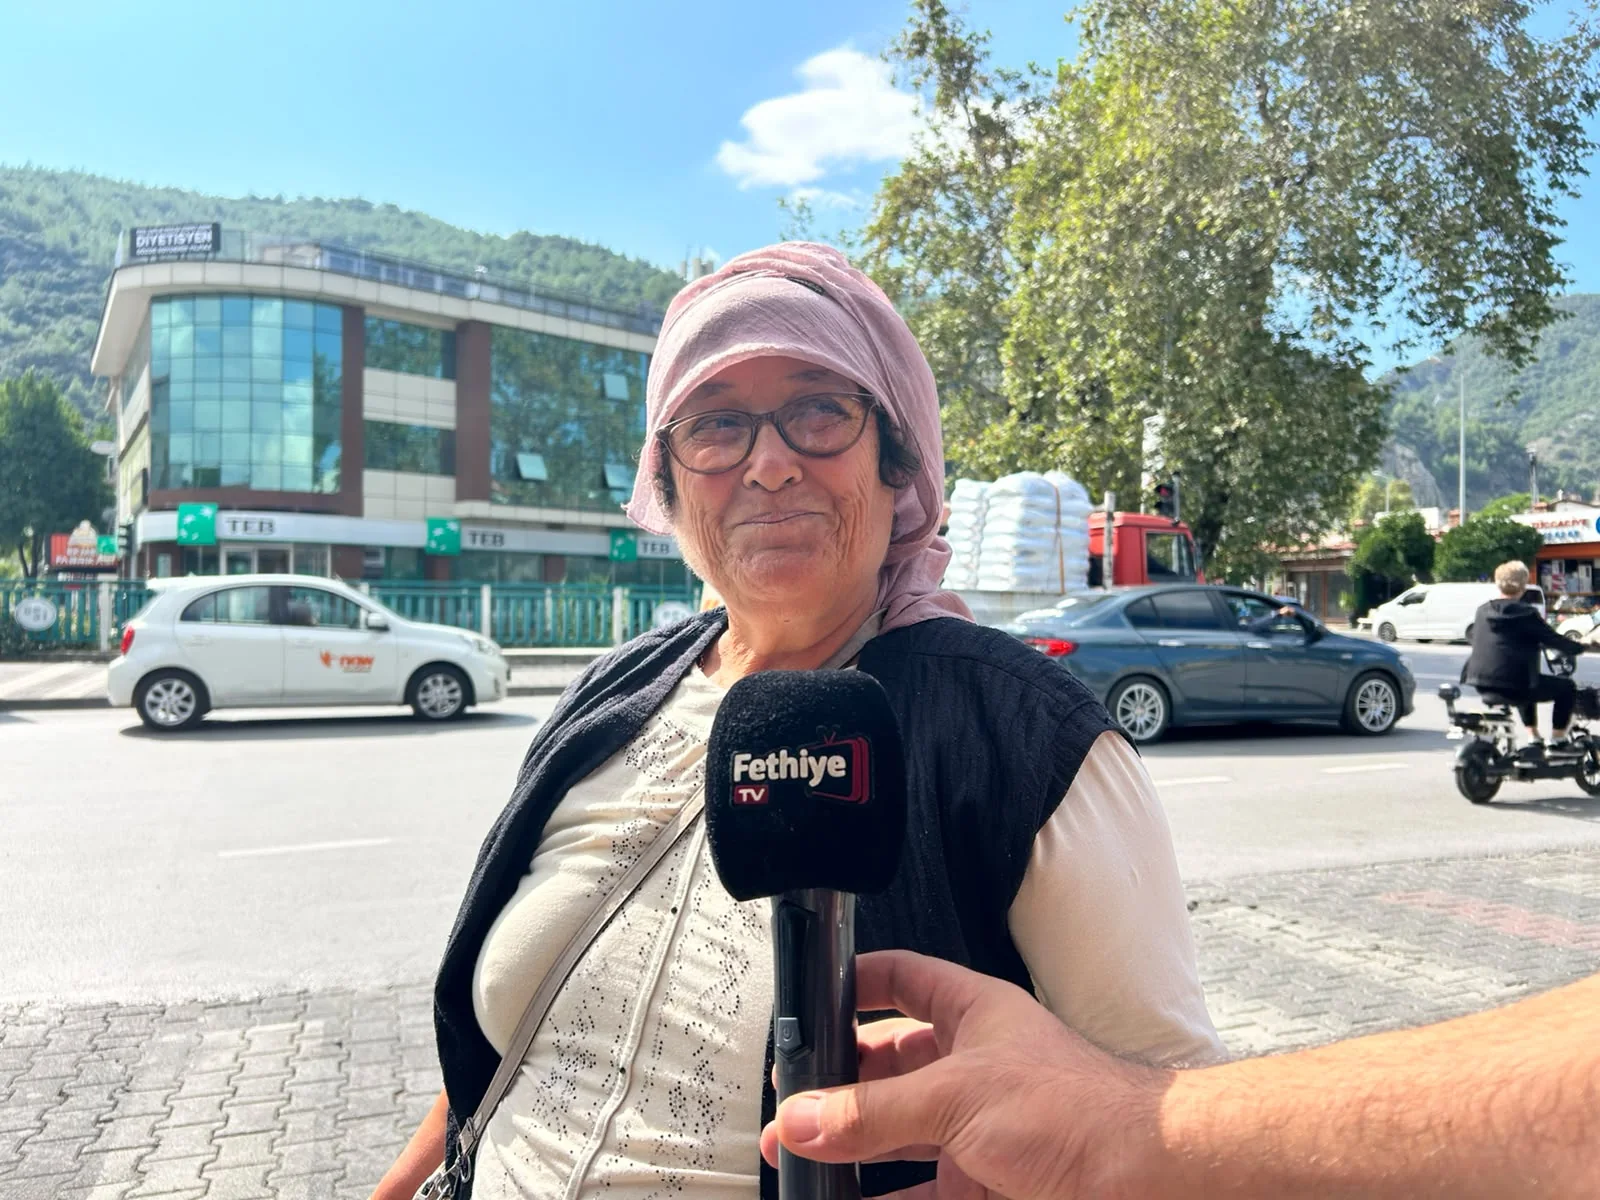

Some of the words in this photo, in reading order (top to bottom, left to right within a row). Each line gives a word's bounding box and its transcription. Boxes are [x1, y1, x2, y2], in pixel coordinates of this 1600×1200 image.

[226, 517, 274, 535] TEB
[468, 530, 505, 547] TEB
[641, 541, 670, 555] TEB
[733, 749, 846, 787] Fethiye
[738, 788, 765, 802] TV
